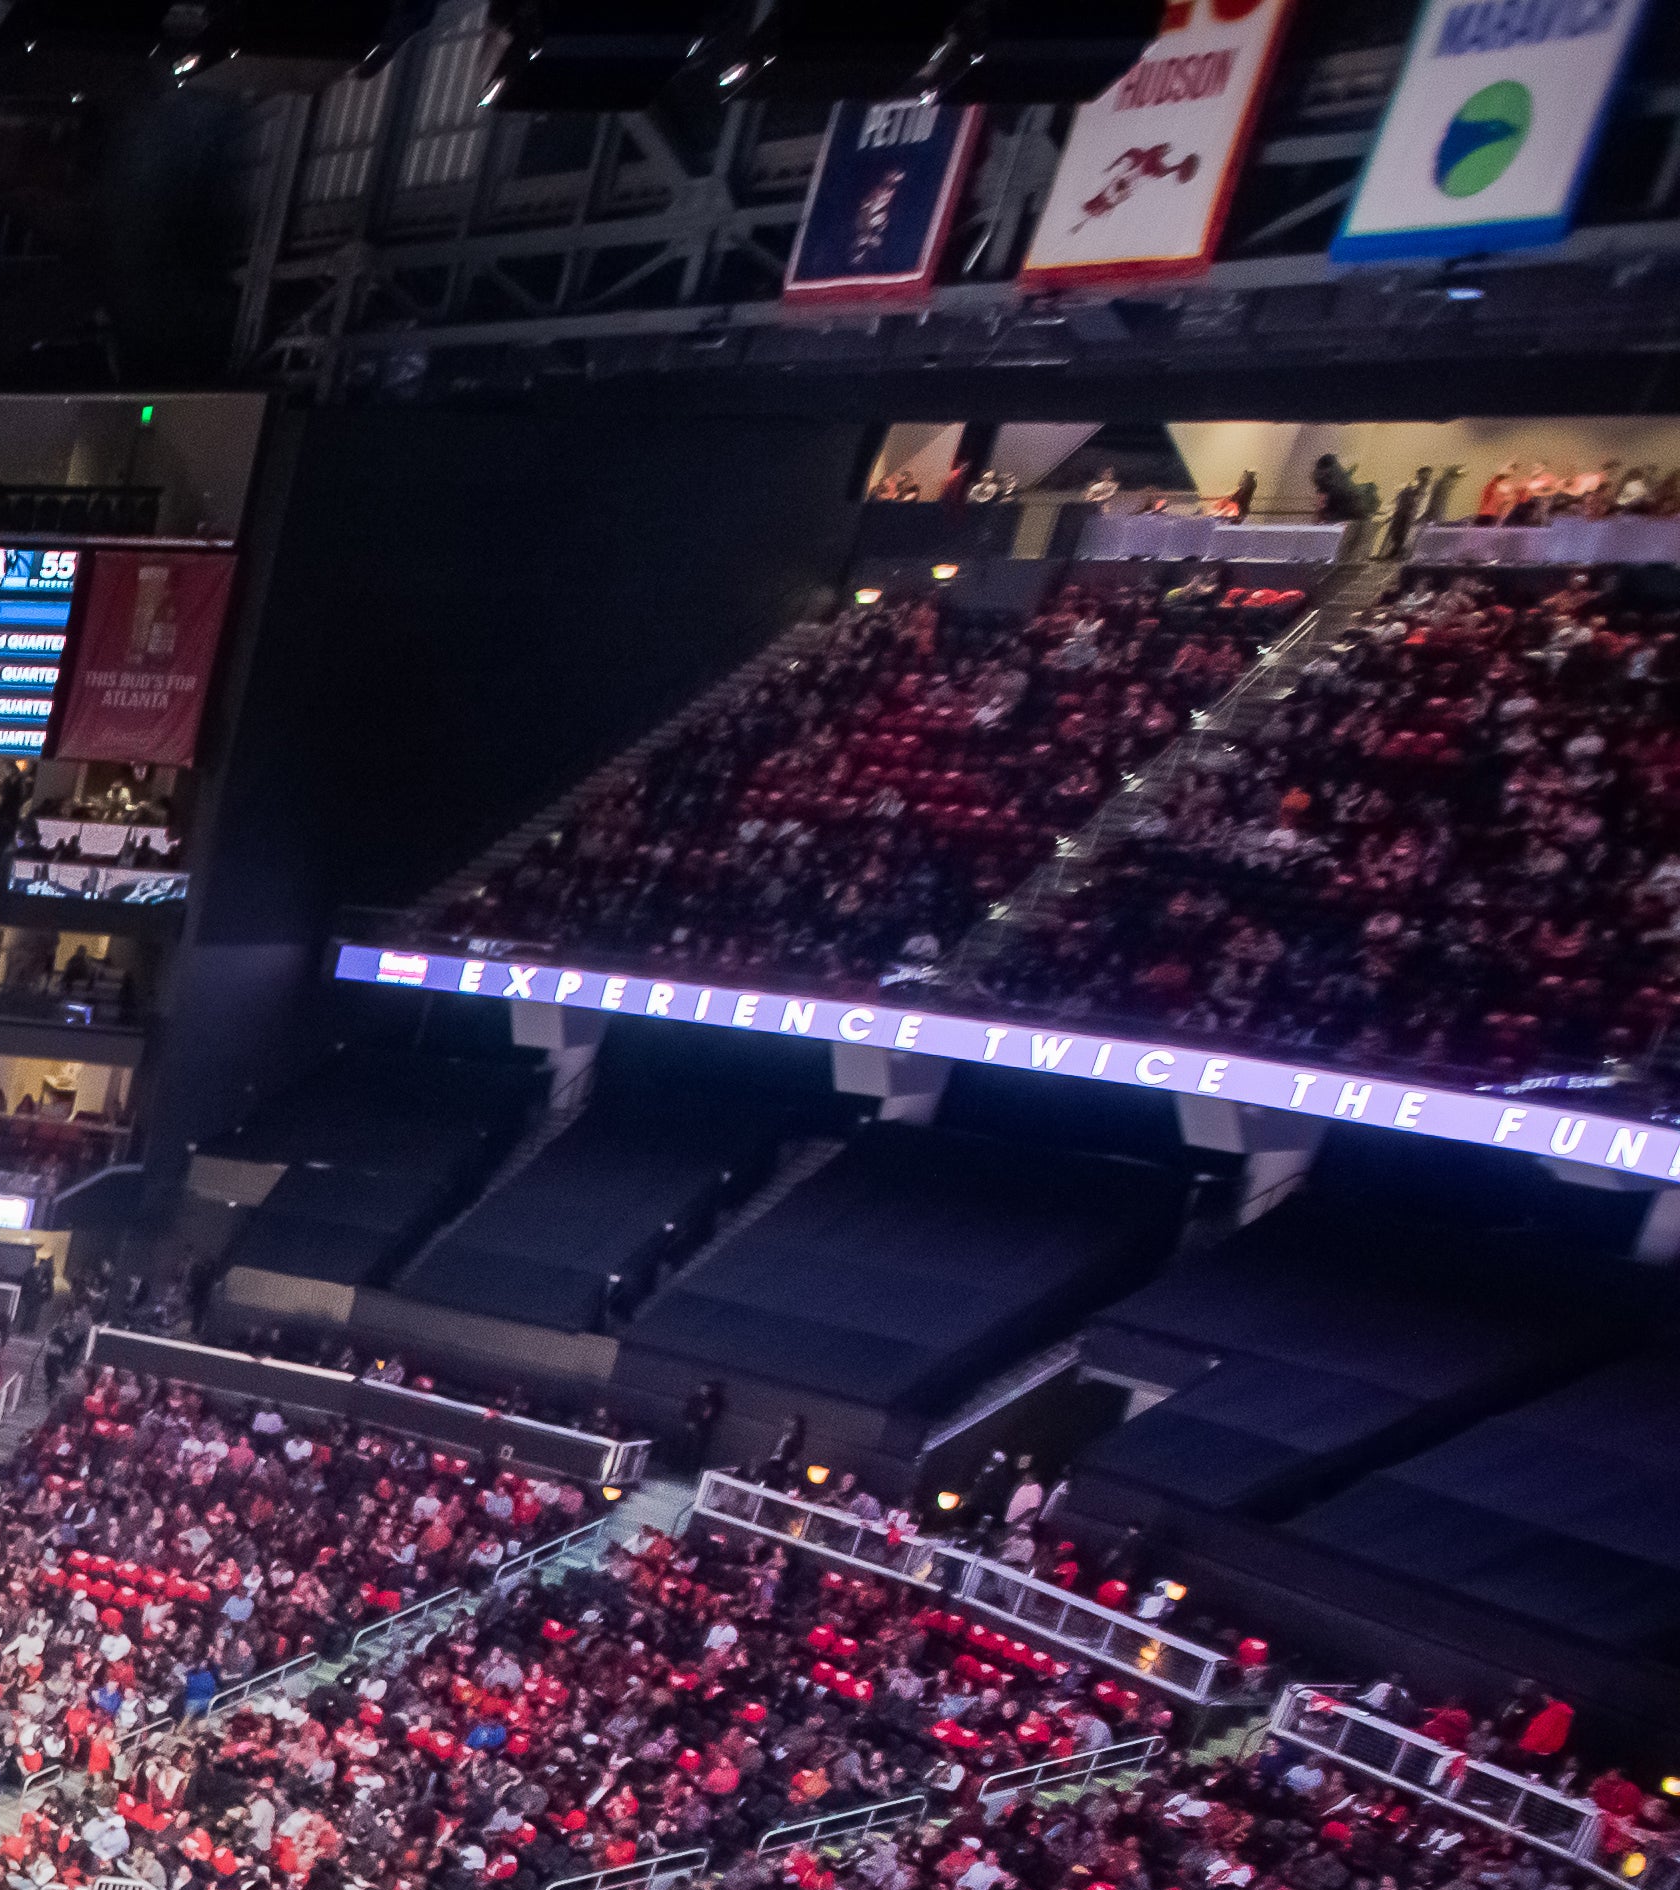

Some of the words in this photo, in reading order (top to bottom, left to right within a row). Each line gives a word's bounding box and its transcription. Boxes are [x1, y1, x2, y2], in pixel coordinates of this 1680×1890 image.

[1115, 48, 1239, 112] HUDSON
[39, 551, 77, 580] 55
[459, 960, 923, 1049] EXPERIENCE
[982, 1026, 1230, 1094] TWICE
[1288, 1073, 1428, 1129] THE
